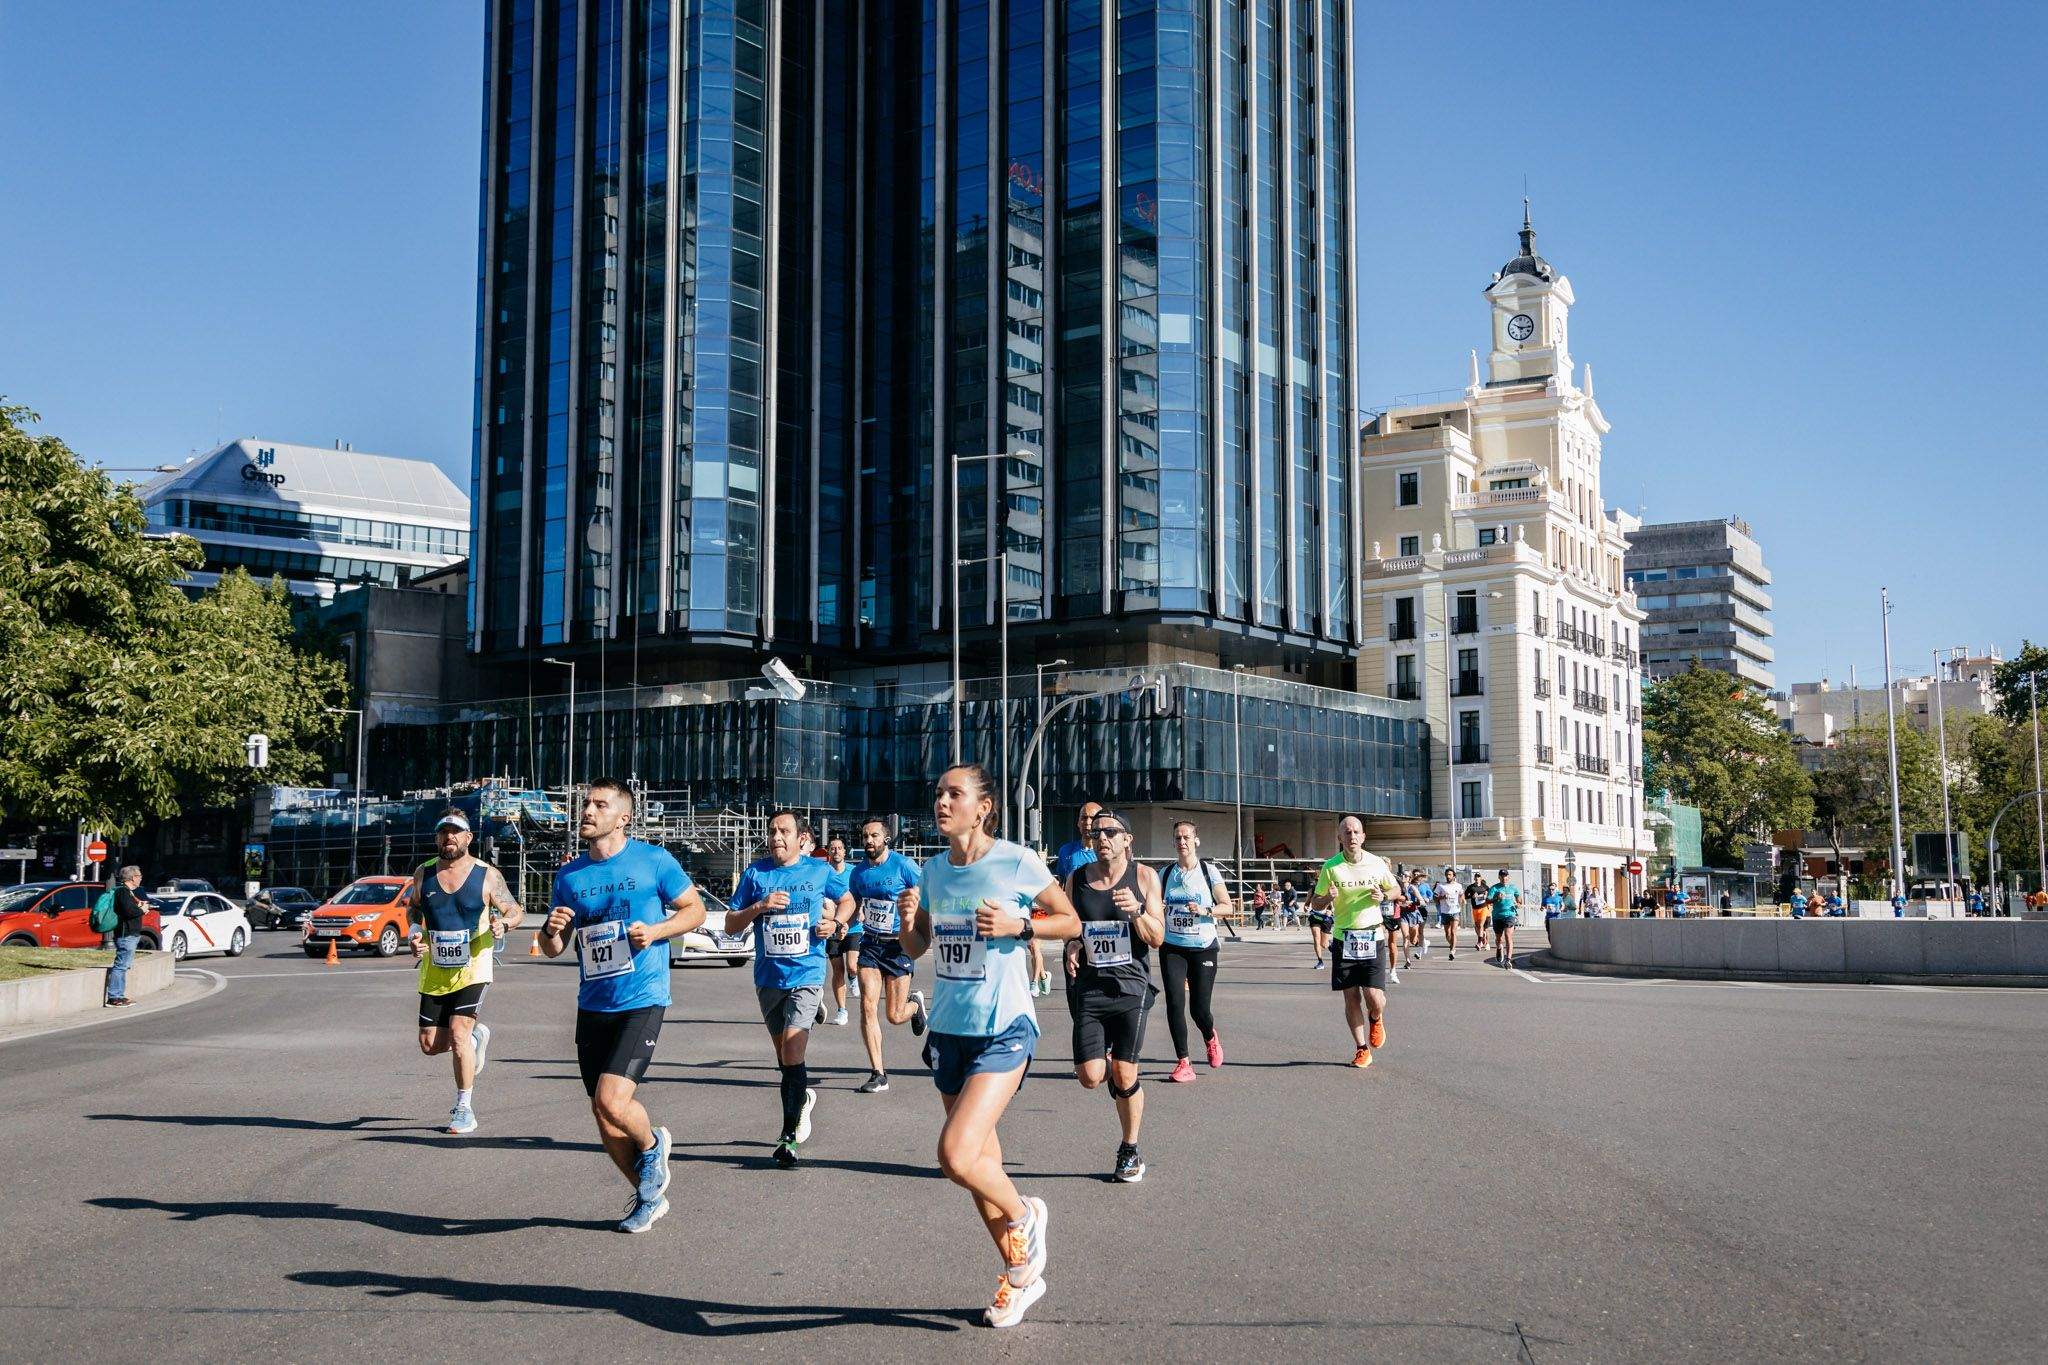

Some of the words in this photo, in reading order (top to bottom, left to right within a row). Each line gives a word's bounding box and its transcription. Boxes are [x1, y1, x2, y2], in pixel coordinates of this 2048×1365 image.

[571, 880, 636, 901] DECIMAS
[869, 911, 887, 923] 2122
[1172, 917, 1194, 928] 1583
[772, 932, 801, 946] 1950
[1350, 941, 1370, 951] 1236
[437, 946, 462, 957] 1966
[592, 945, 613, 963] 427
[939, 943, 971, 964] 1797
[1093, 940, 1116, 954] 201
